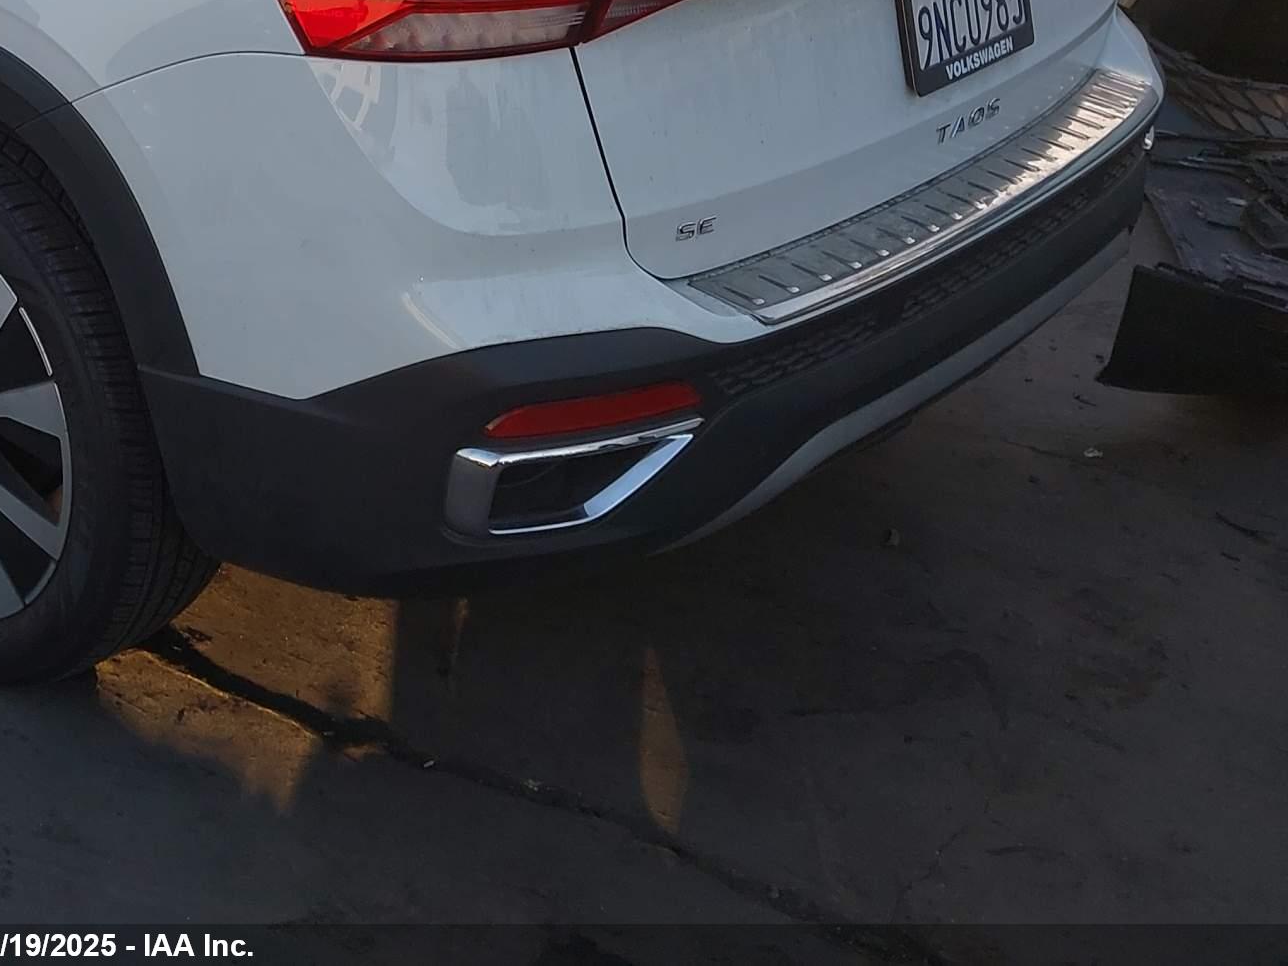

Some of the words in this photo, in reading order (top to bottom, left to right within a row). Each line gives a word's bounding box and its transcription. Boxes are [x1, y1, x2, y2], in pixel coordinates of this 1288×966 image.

[946, 37, 1014, 81] VOLKSWAGEN
[935, 97, 1001, 146] TAOS
[675, 215, 717, 242] SE
